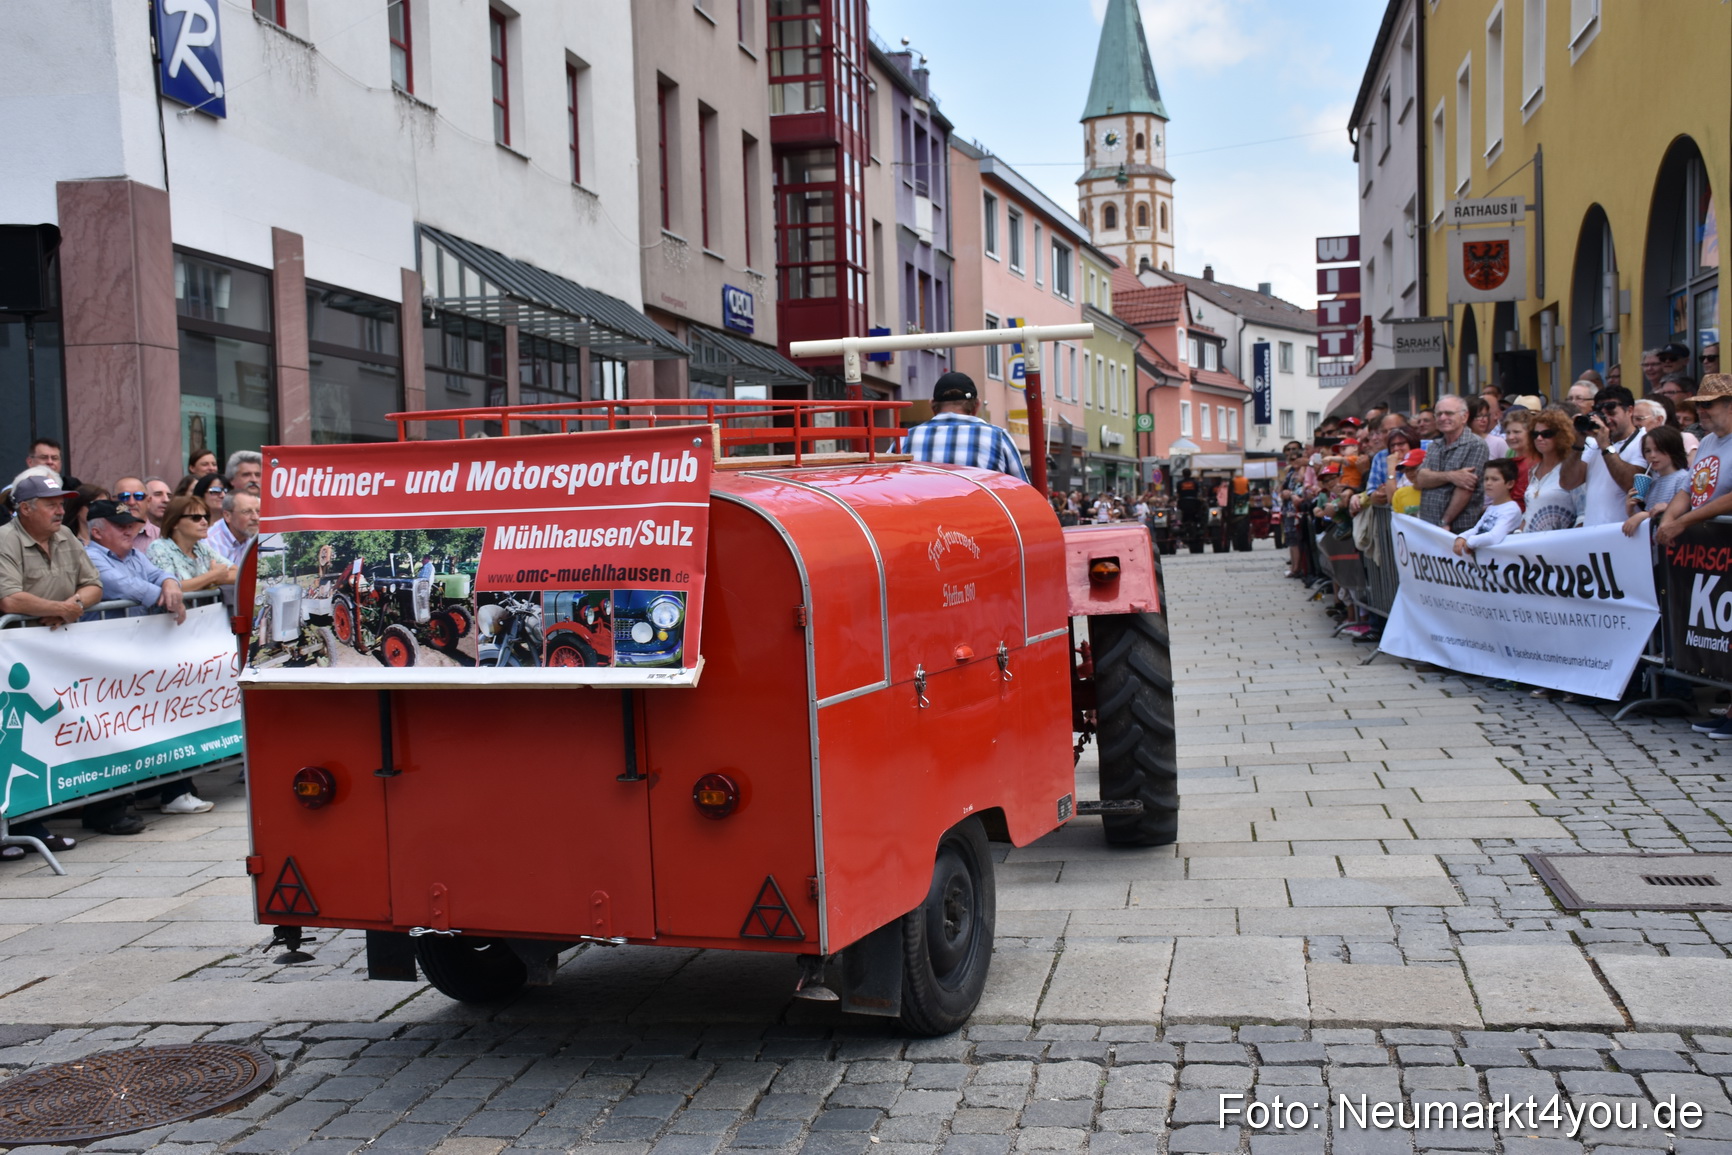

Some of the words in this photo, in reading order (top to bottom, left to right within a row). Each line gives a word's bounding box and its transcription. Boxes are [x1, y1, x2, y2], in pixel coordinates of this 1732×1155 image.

[1454, 203, 1508, 218] RATHAUS
[1510, 202, 1518, 214] II
[1396, 337, 1430, 350] SARAH
[1432, 335, 1441, 347] K
[1263, 348, 1271, 389] TAILOR
[270, 466, 396, 498] Oldtimer-
[405, 461, 459, 494] und
[466, 450, 698, 495] Motorsportclub
[493, 519, 694, 550] Mühlhausen/Sulz
[487, 563, 690, 584] www.omc-muehlhausen.de
[1420, 593, 1432, 606] DAS
[1432, 595, 1511, 622] NACHRICHTENPORTAL
[1512, 606, 1534, 624] FÜR
[1536, 611, 1631, 631] NEUMARKT/OPF.
[1685, 629, 1729, 653] Neumarkt
[97, 669, 155, 703] UNS
[156, 651, 228, 693] LÄUFT
[57, 763, 132, 790] Service-Line:
[200, 734, 243, 753] www.jura-
